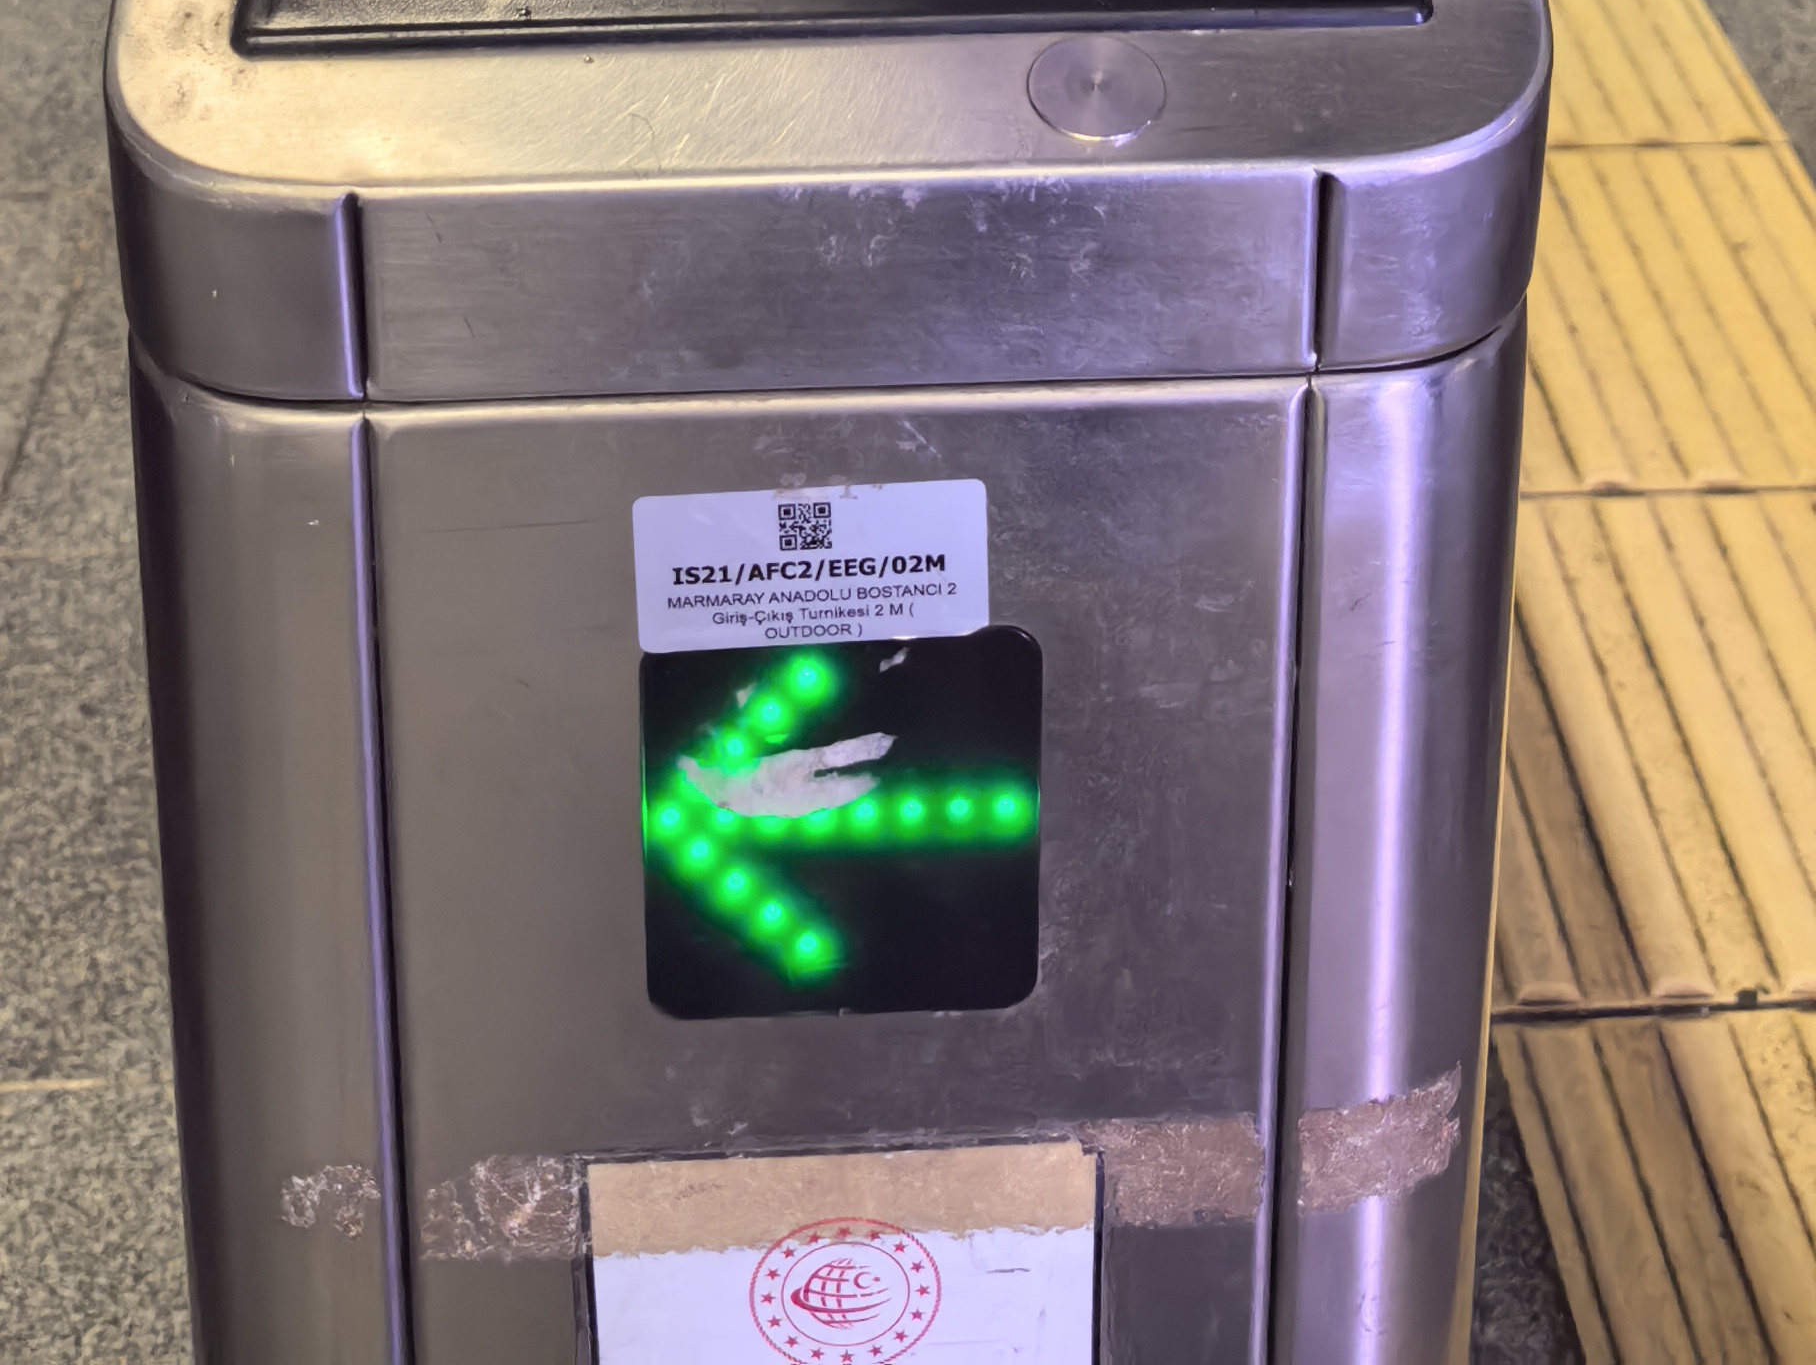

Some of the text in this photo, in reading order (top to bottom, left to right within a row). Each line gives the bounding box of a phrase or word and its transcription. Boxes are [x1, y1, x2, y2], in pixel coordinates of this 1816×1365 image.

[672, 554, 946, 586] IS21/AFC2/EEG/02M
[667, 582, 957, 610] MARMARAY ANADOLU BOSTANCI 2
[712, 610, 794, 626] Giriş-Çıkış
[799, 604, 870, 620] Turnikesi
[874, 604, 884, 616] 2
[889, 603, 904, 616] M
[764, 623, 852, 639] OUTDOOR
